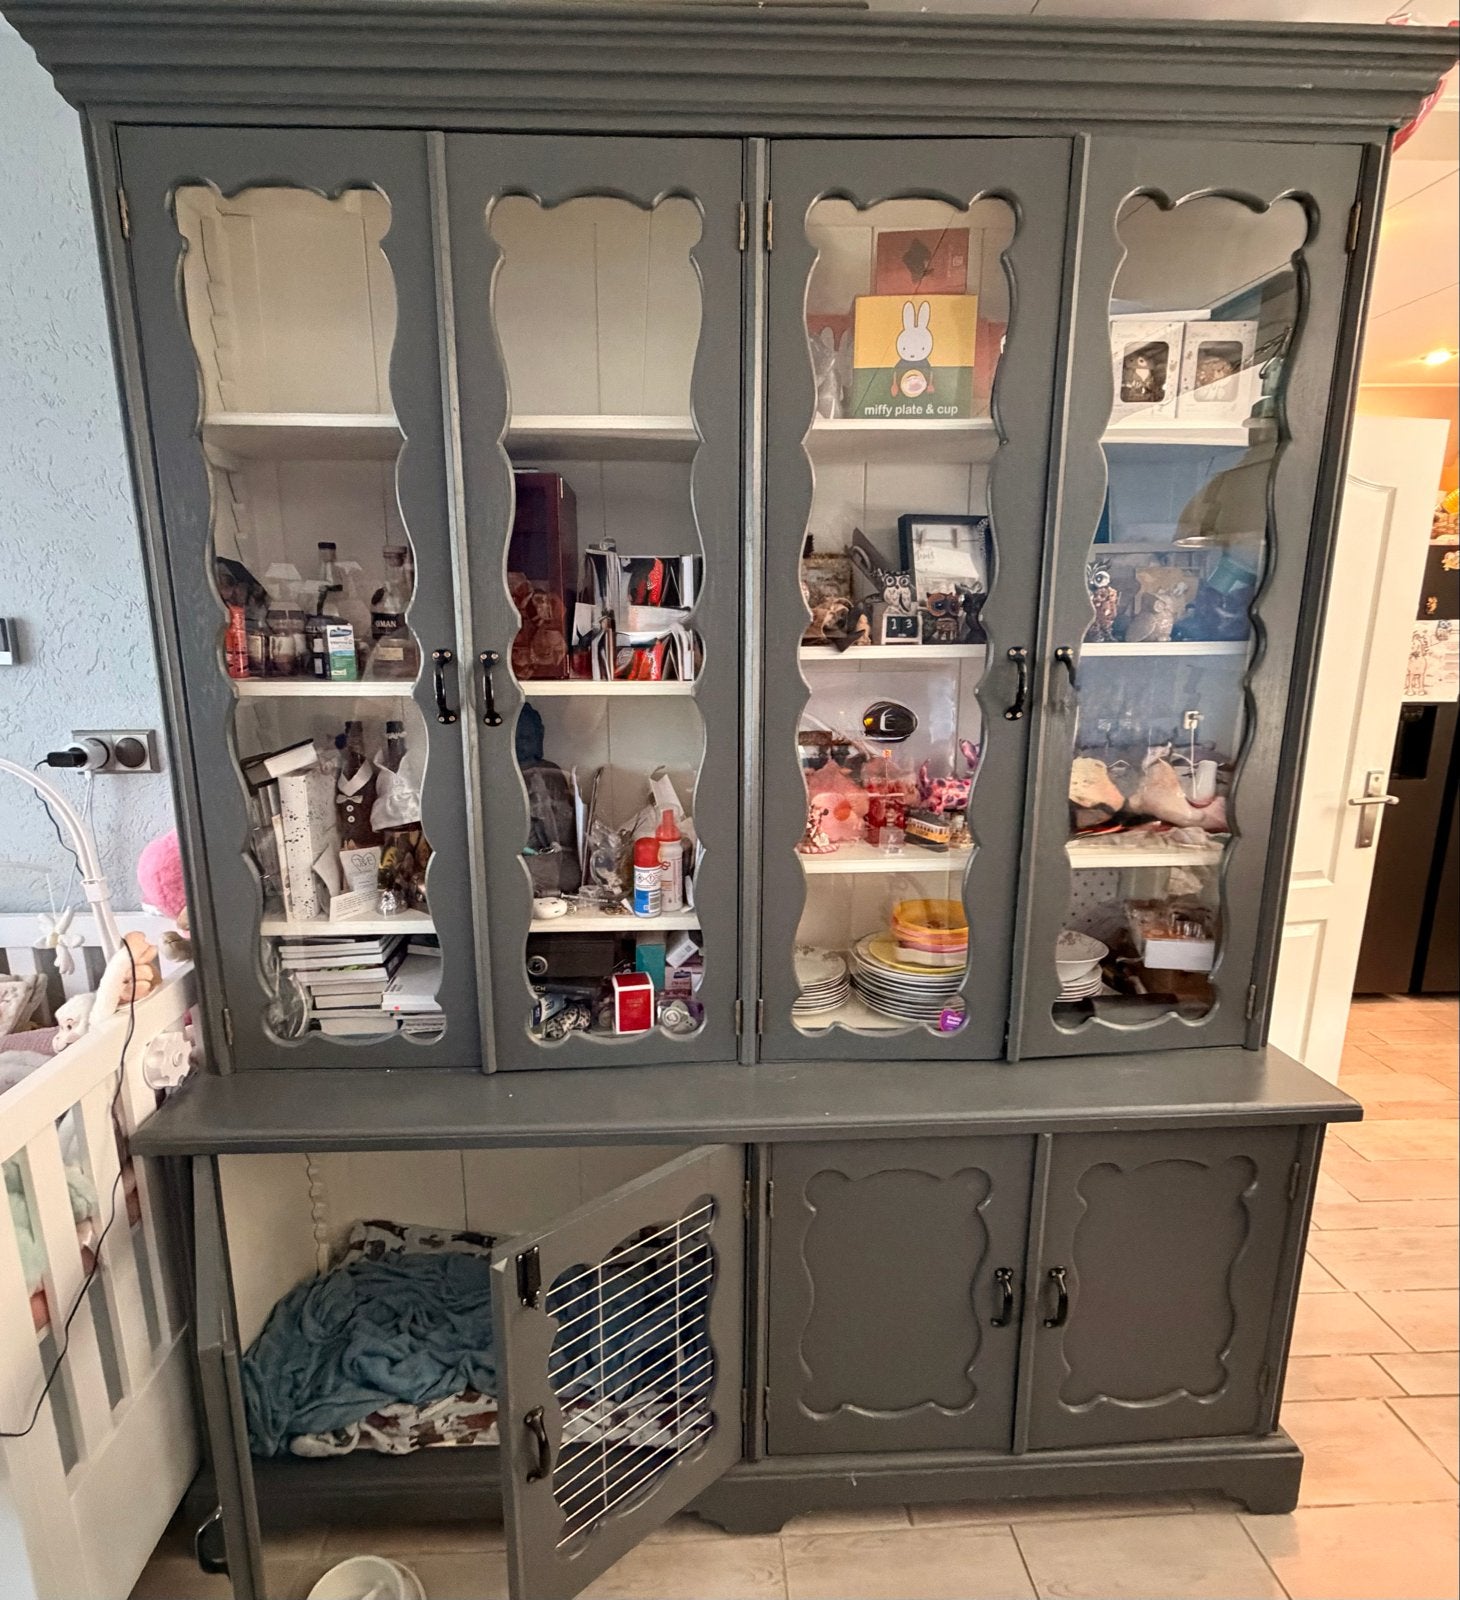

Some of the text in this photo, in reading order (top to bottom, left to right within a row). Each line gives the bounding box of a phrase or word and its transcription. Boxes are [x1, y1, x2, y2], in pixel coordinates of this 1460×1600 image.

[864, 404, 958, 417] miffy plate & cup
